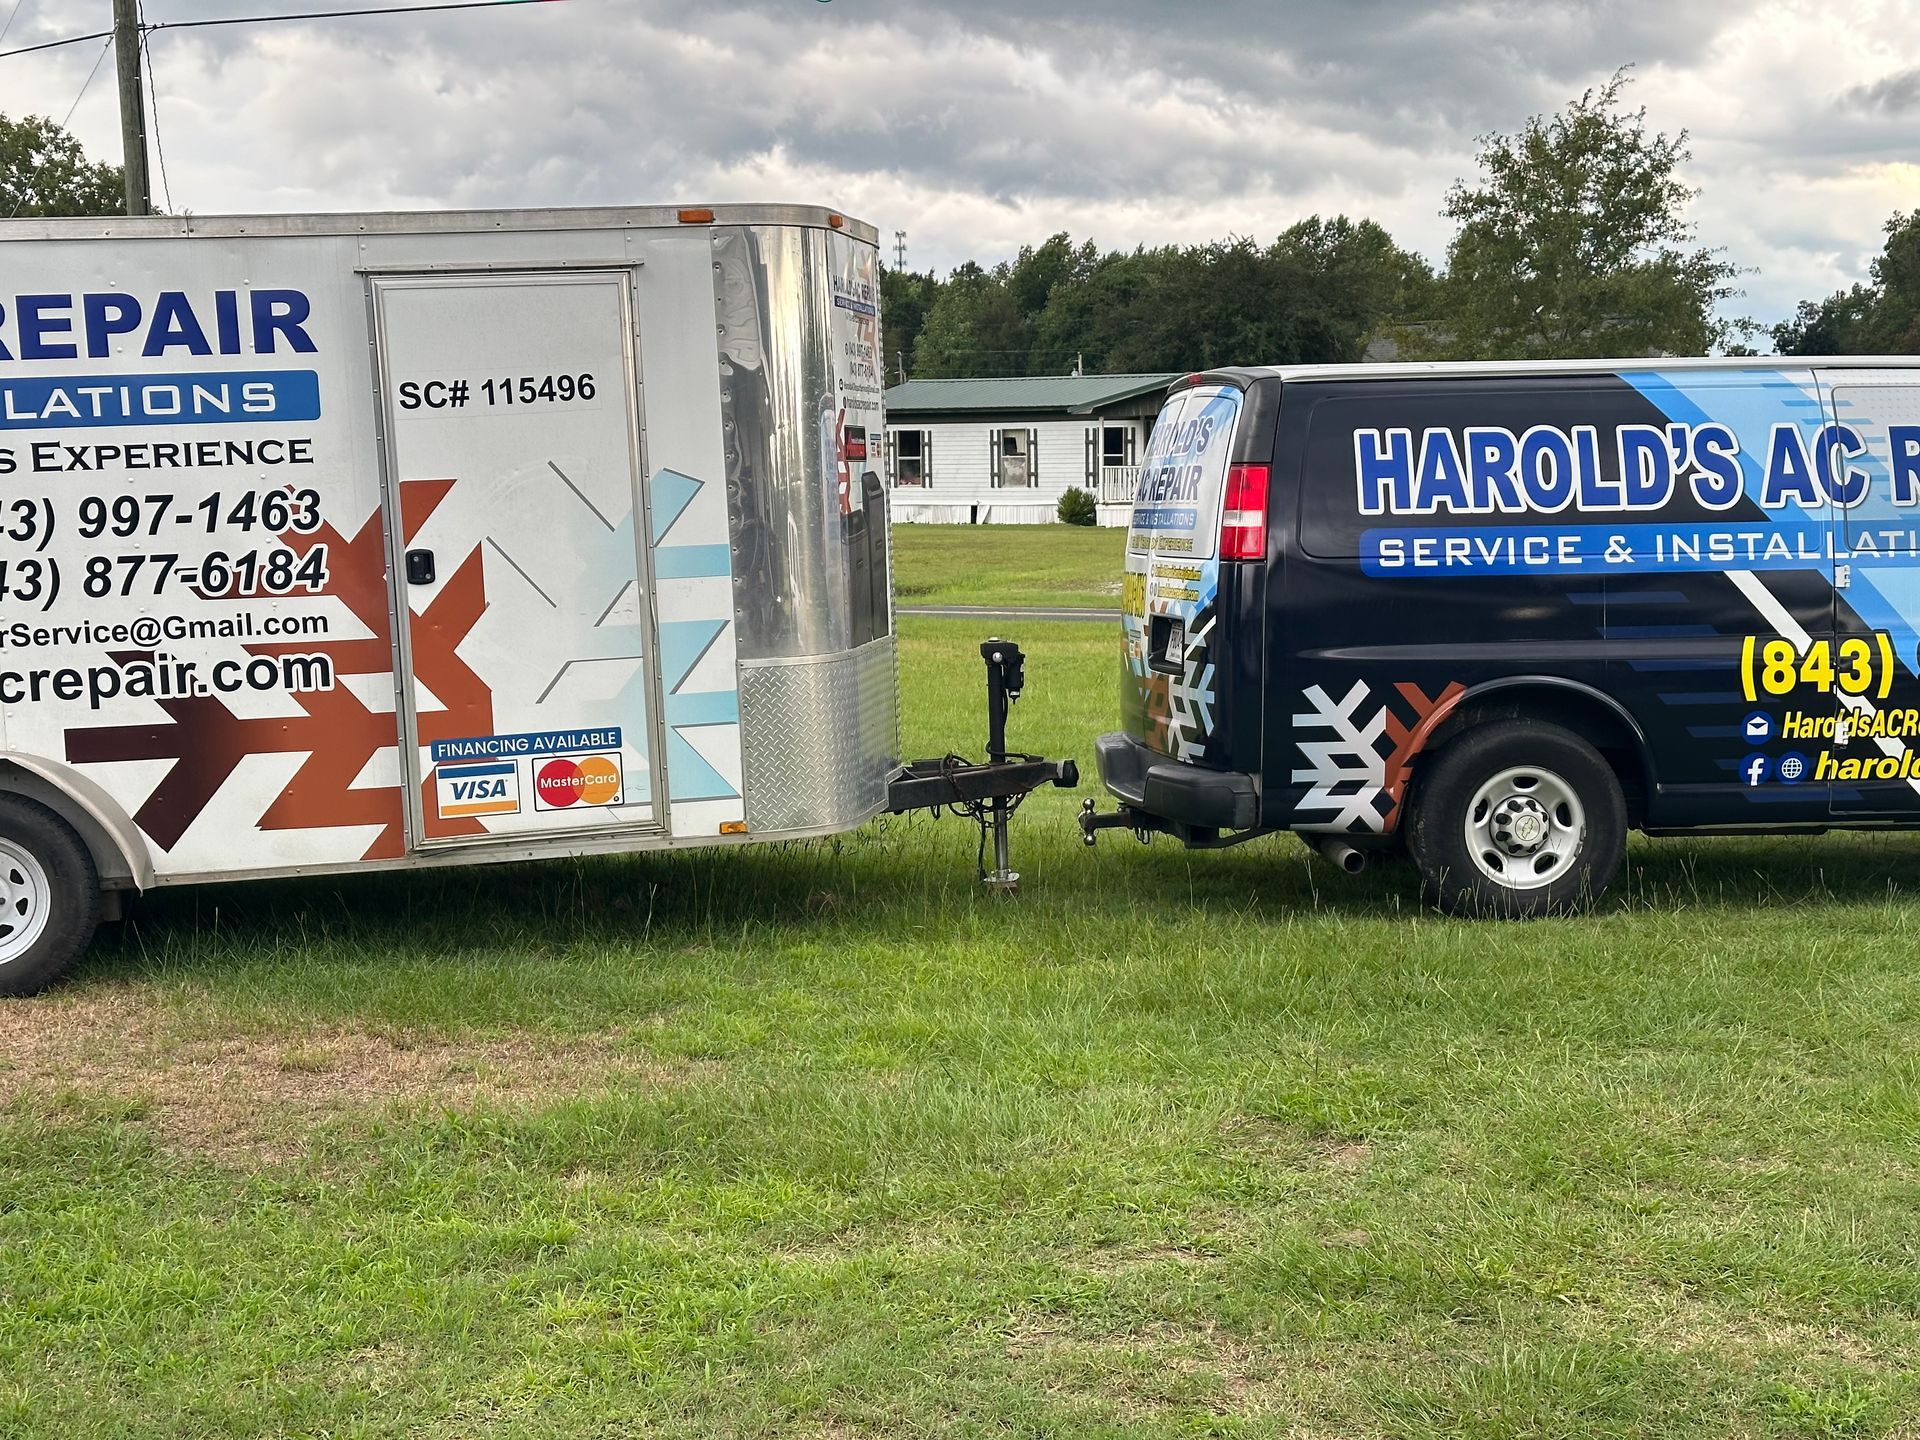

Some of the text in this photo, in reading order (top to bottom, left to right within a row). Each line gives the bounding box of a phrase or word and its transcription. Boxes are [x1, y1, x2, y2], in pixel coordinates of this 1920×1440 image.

[0, 289, 319, 361] EPAIR
[4, 382, 276, 420] LATIONS
[399, 373, 596, 410] SC# 115496
[1149, 465, 1203, 502] REPAIR
[1354, 423, 1744, 515] HAROLD'S
[1761, 423, 1870, 508] AC
[0, 488, 321, 552] 3) 997-1463
[1379, 530, 1917, 568] SERVICE & INSTALLATI
[83, 547, 326, 598] 877-6184
[0, 652, 331, 711] crepair.com
[1741, 633, 1894, 702] (843)
[438, 731, 617, 757] FINANCING AVAILABLE
[450, 772, 617, 801] VISA MasterCard
